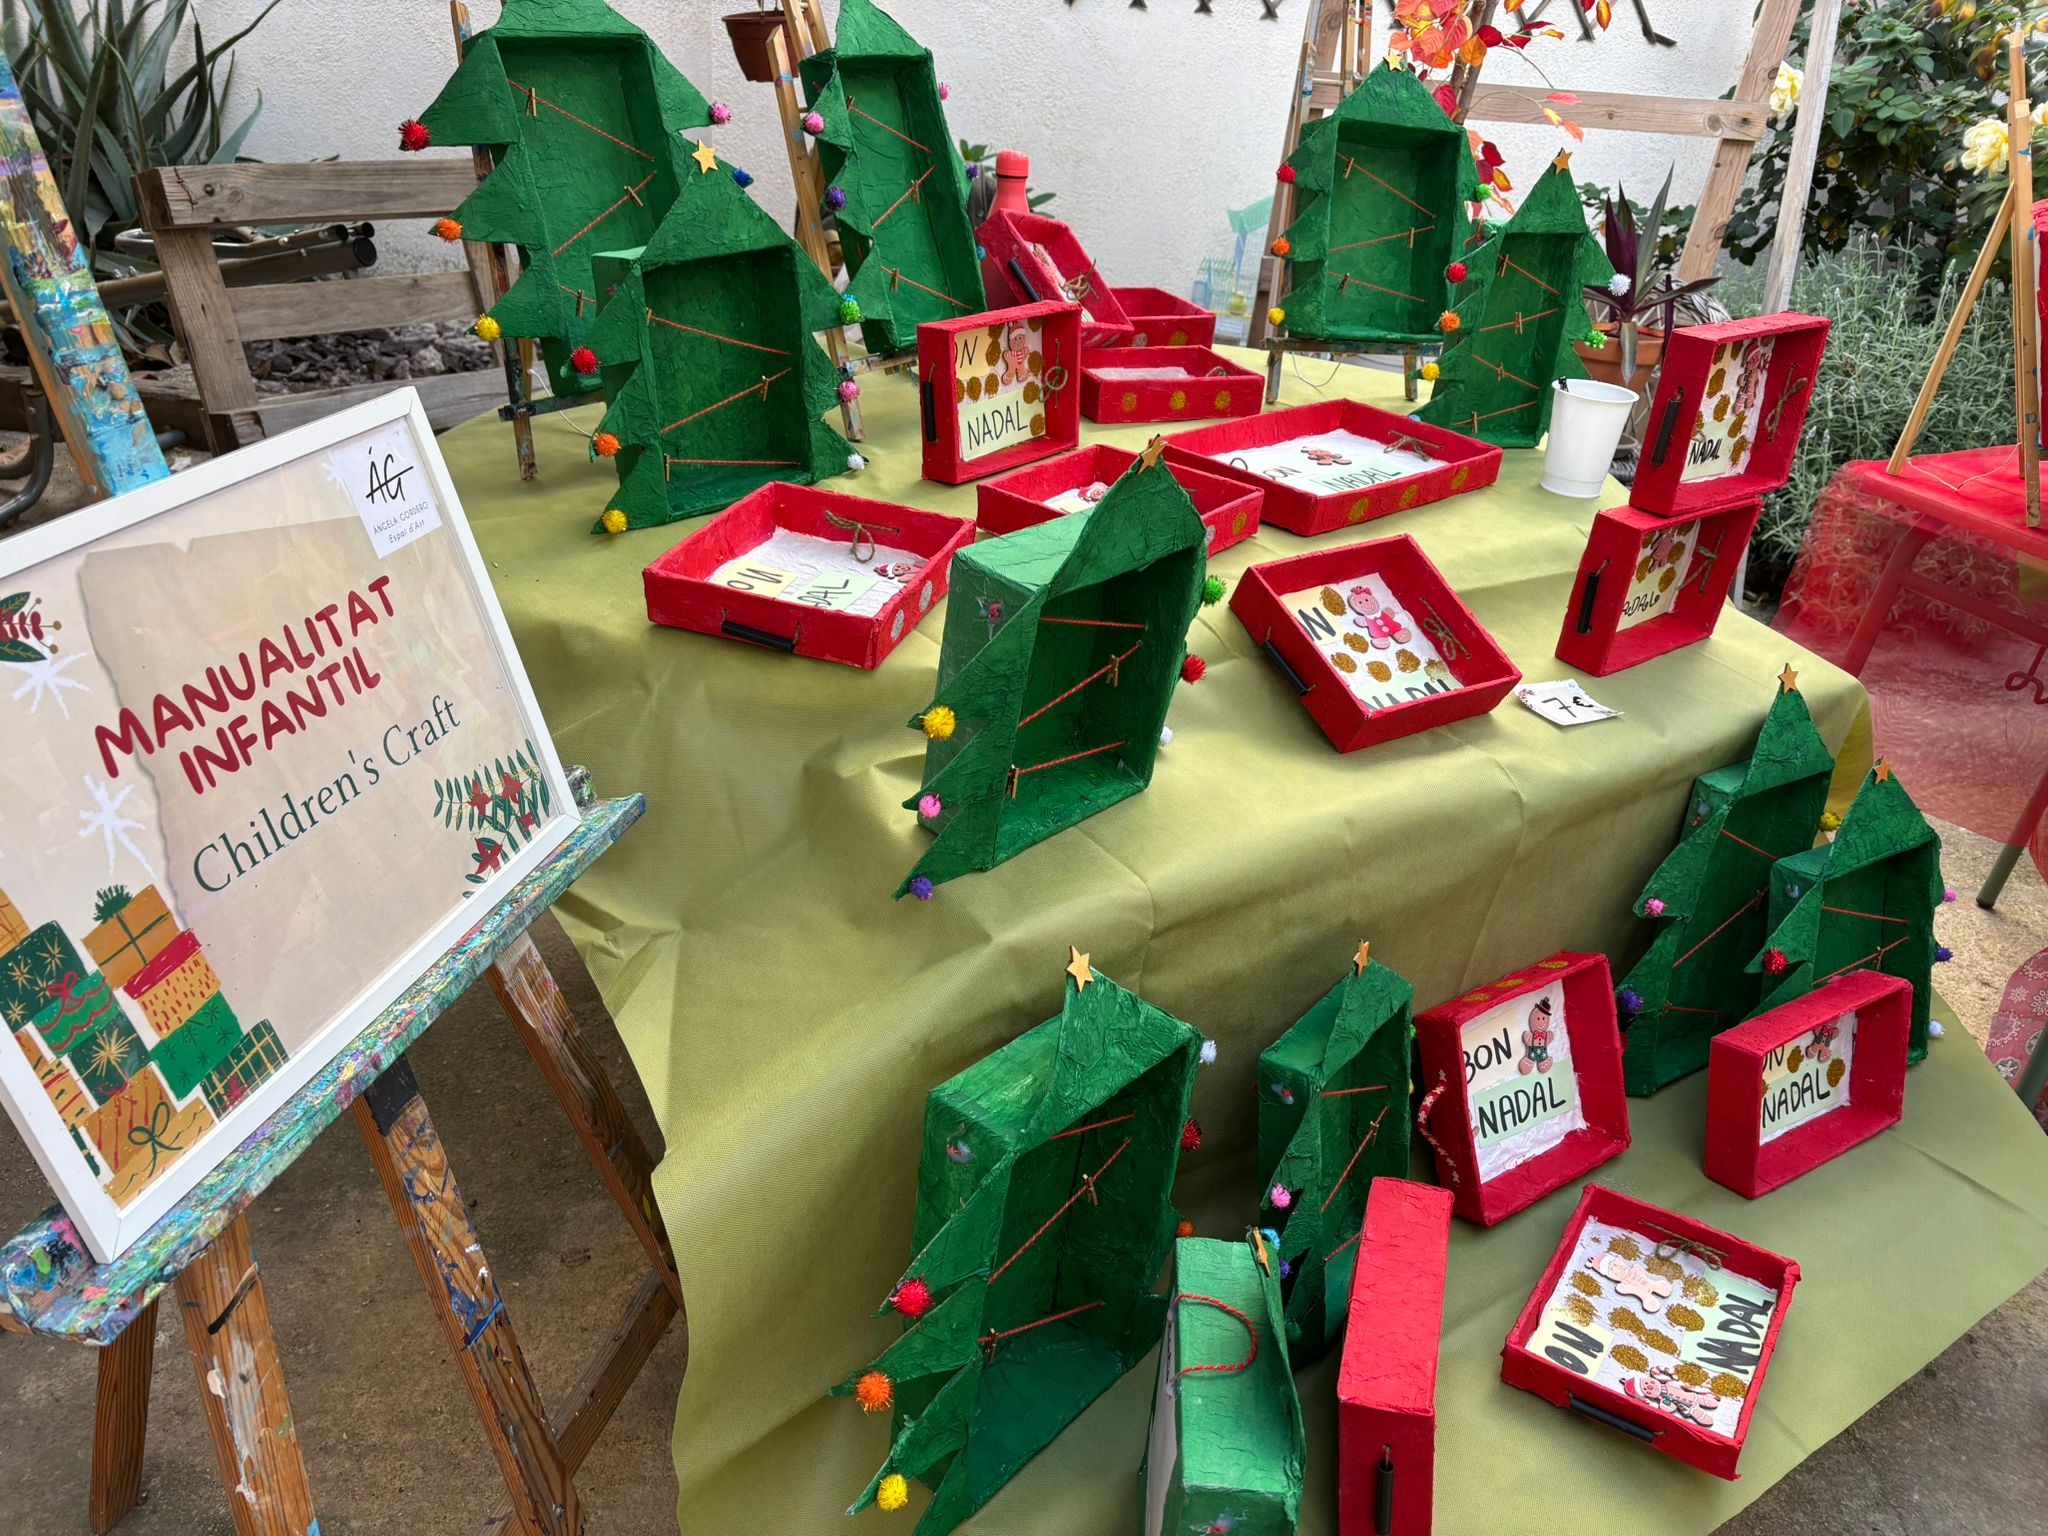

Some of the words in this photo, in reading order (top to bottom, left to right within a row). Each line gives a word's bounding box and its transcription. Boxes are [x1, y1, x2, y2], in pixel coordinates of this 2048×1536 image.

[967, 400, 1029, 451] NADAL
[1687, 438, 1723, 467] NADAL
[1322, 467, 1402, 491] NADAL
[95, 575, 394, 778] MANUALITAT
[179, 646, 381, 795] INFANTIL
[193, 749, 380, 893] Children's
[382, 694, 461, 766] Craft
[1477, 1076, 1567, 1139] NADAL
[1762, 1068, 1831, 1129] NADAL
[1695, 1293, 1776, 1375] NADAL
